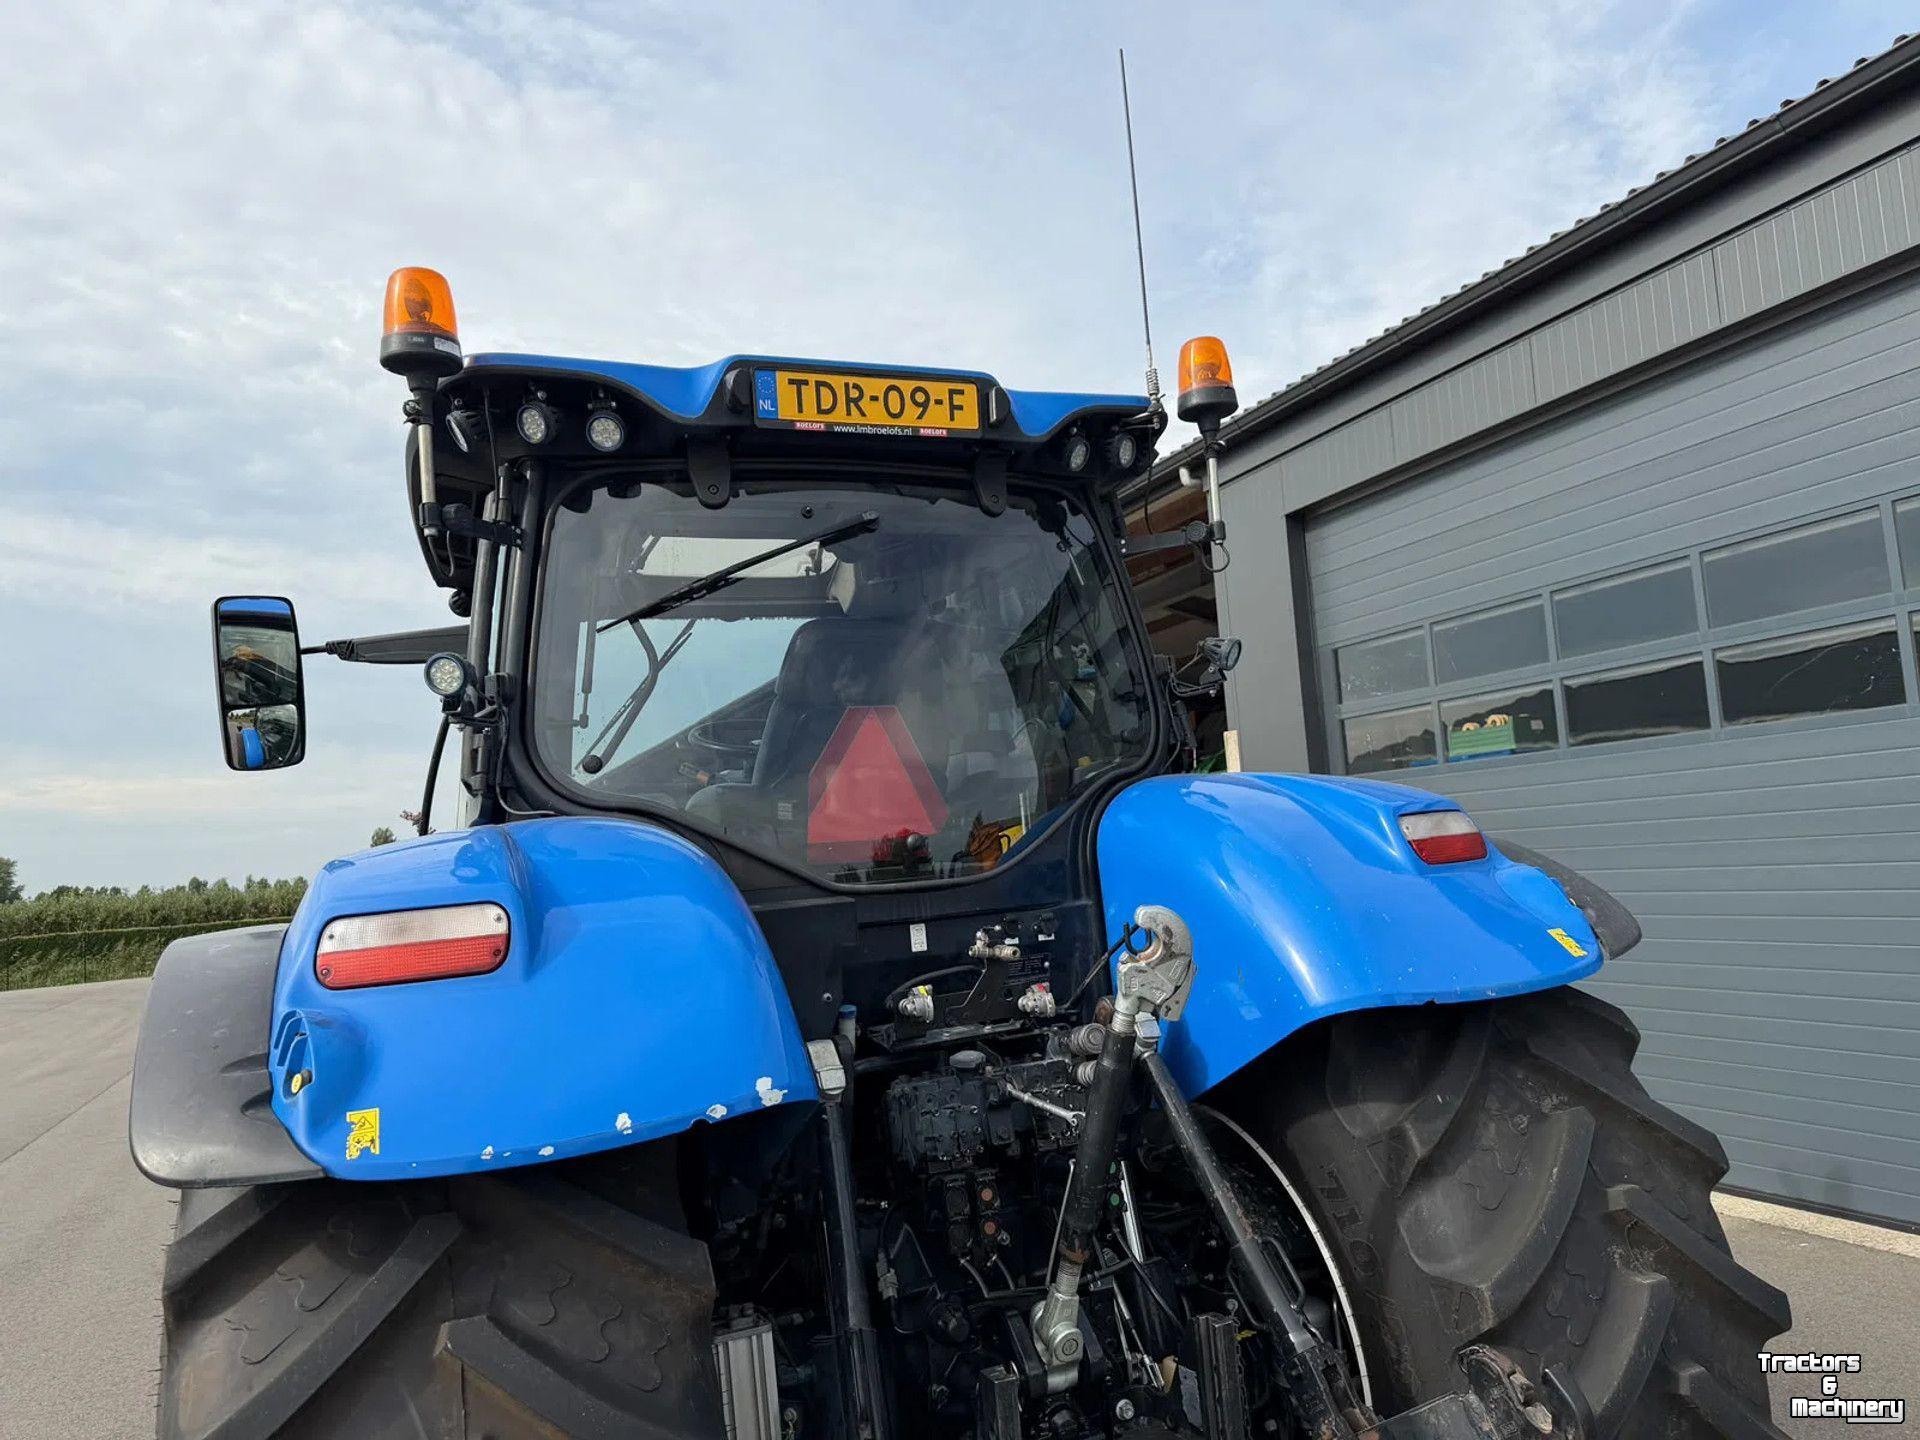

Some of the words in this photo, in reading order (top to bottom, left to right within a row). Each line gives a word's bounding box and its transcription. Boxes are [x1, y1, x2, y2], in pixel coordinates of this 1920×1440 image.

[759, 399, 776, 412] NL
[787, 378, 965, 422] TDR-09-F
[833, 424, 913, 436] www.lmbroelofs.nl
